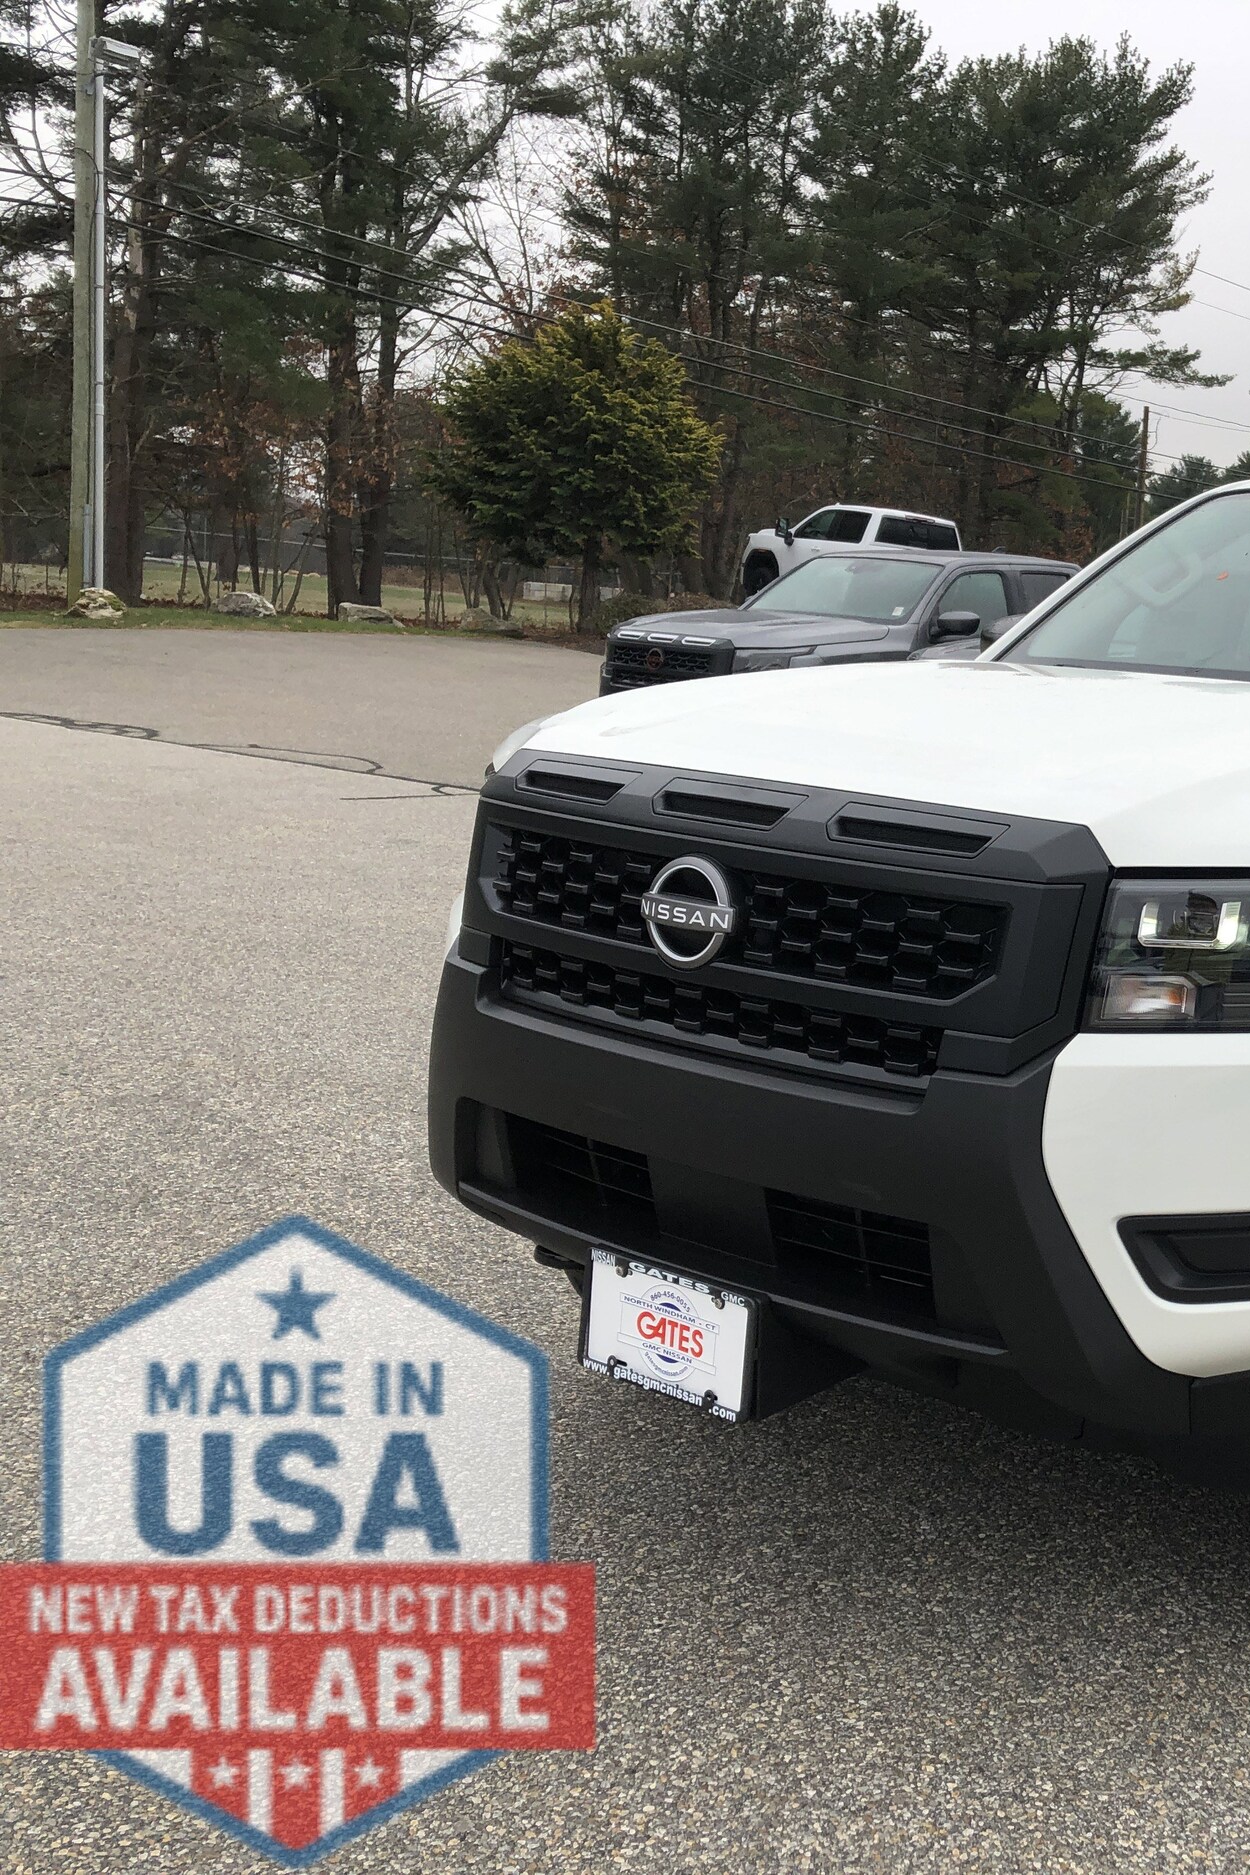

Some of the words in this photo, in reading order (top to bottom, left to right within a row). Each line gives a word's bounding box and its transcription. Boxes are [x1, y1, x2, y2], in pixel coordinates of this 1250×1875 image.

[641, 898, 729, 929] NISSAN
[591, 1248, 616, 1267] NISSAN
[628, 1262, 711, 1294] GATES
[720, 1292, 745, 1307] GMC
[623, 1296, 653, 1309] NORTH
[654, 1305, 696, 1324] WINDHAM
[705, 1323, 716, 1331] CT
[650, 1291, 691, 1313] 860-456-0055
[636, 1311, 704, 1358] GATES
[642, 1342, 661, 1353] GMC
[663, 1349, 693, 1364] NISSAN
[613, 1365, 703, 1407] gatesgmcnissan
